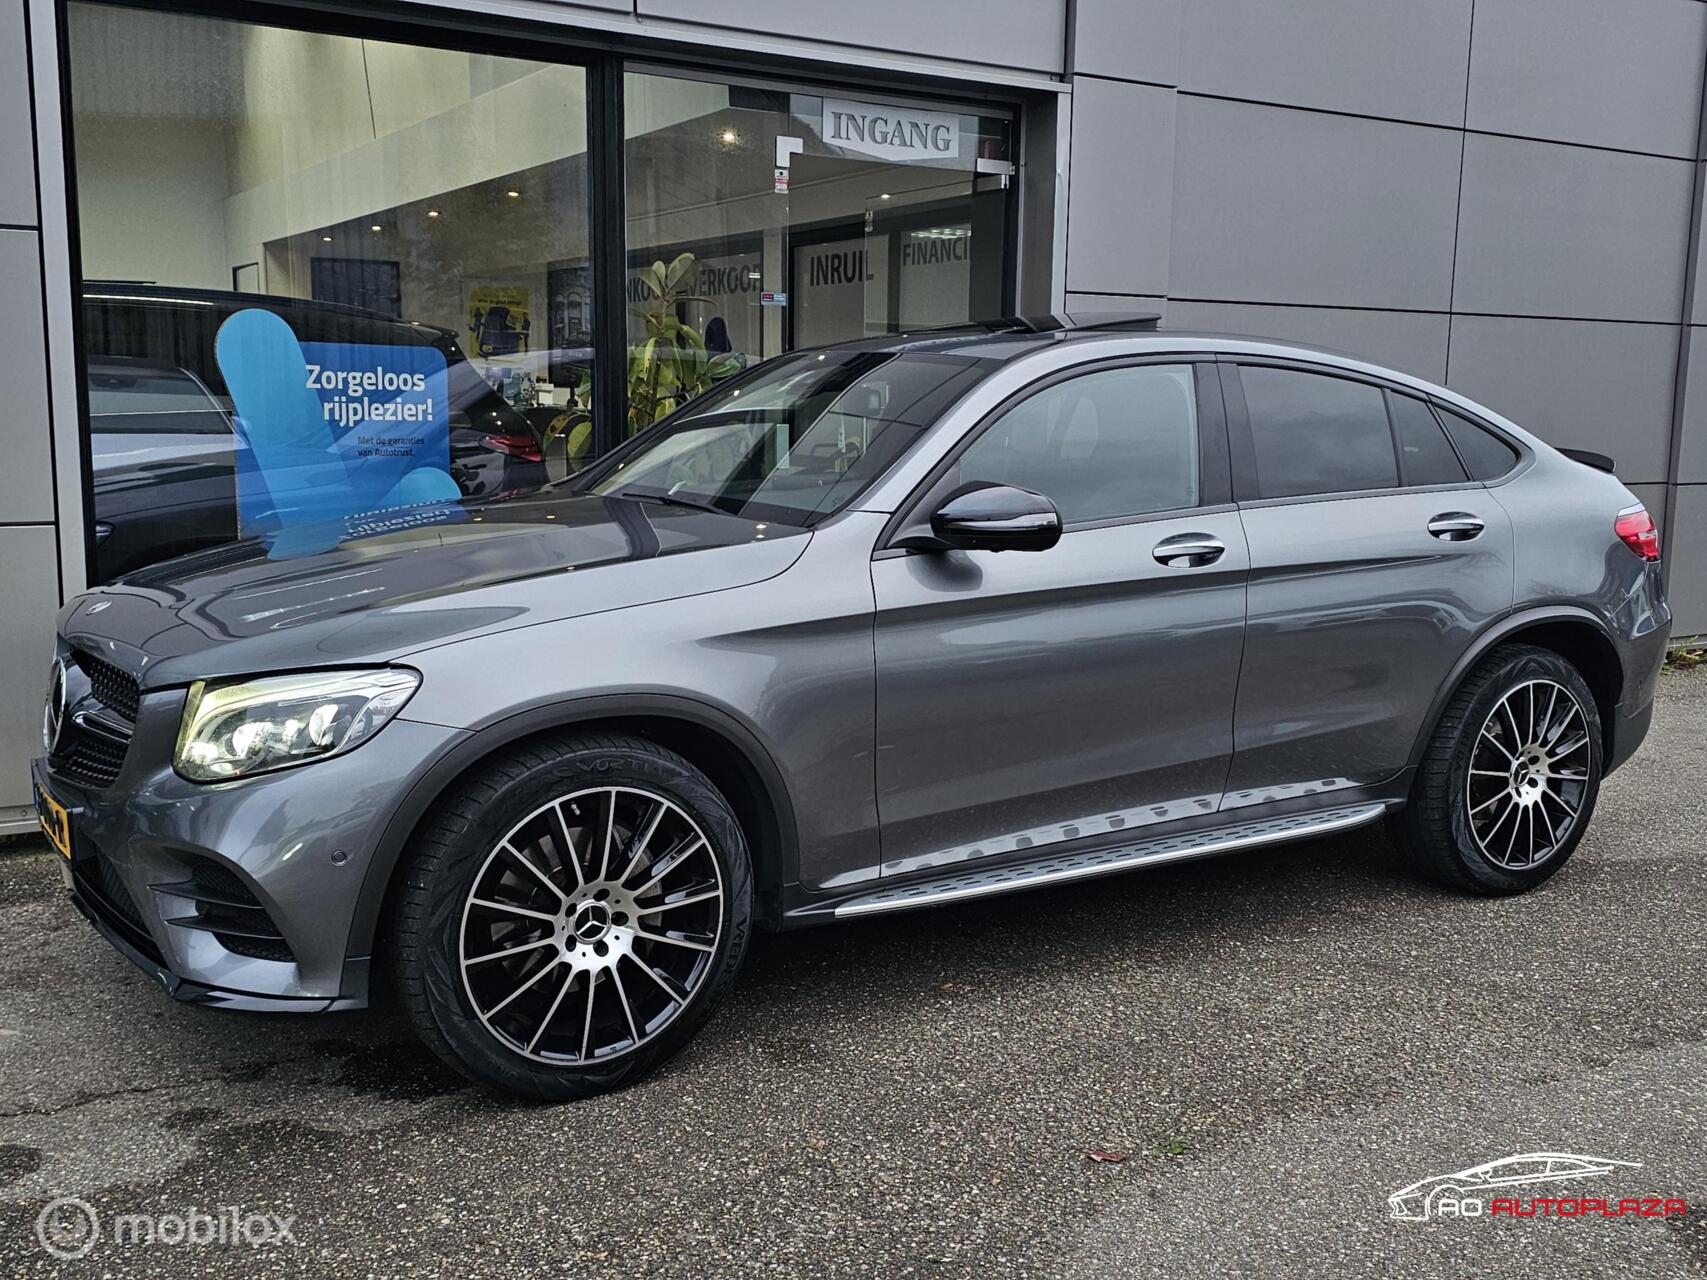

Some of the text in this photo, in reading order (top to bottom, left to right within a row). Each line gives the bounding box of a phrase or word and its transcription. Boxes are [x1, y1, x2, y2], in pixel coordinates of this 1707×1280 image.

[831, 111, 951, 151] INGANG
[810, 248, 875, 286] INRUIL
[305, 365, 425, 397] Zorgeloos
[323, 396, 433, 427] rijplezier!
[357, 436, 374, 445] Met
[387, 436, 425, 447] garanties
[357, 447, 416, 457] van Autotrust.
